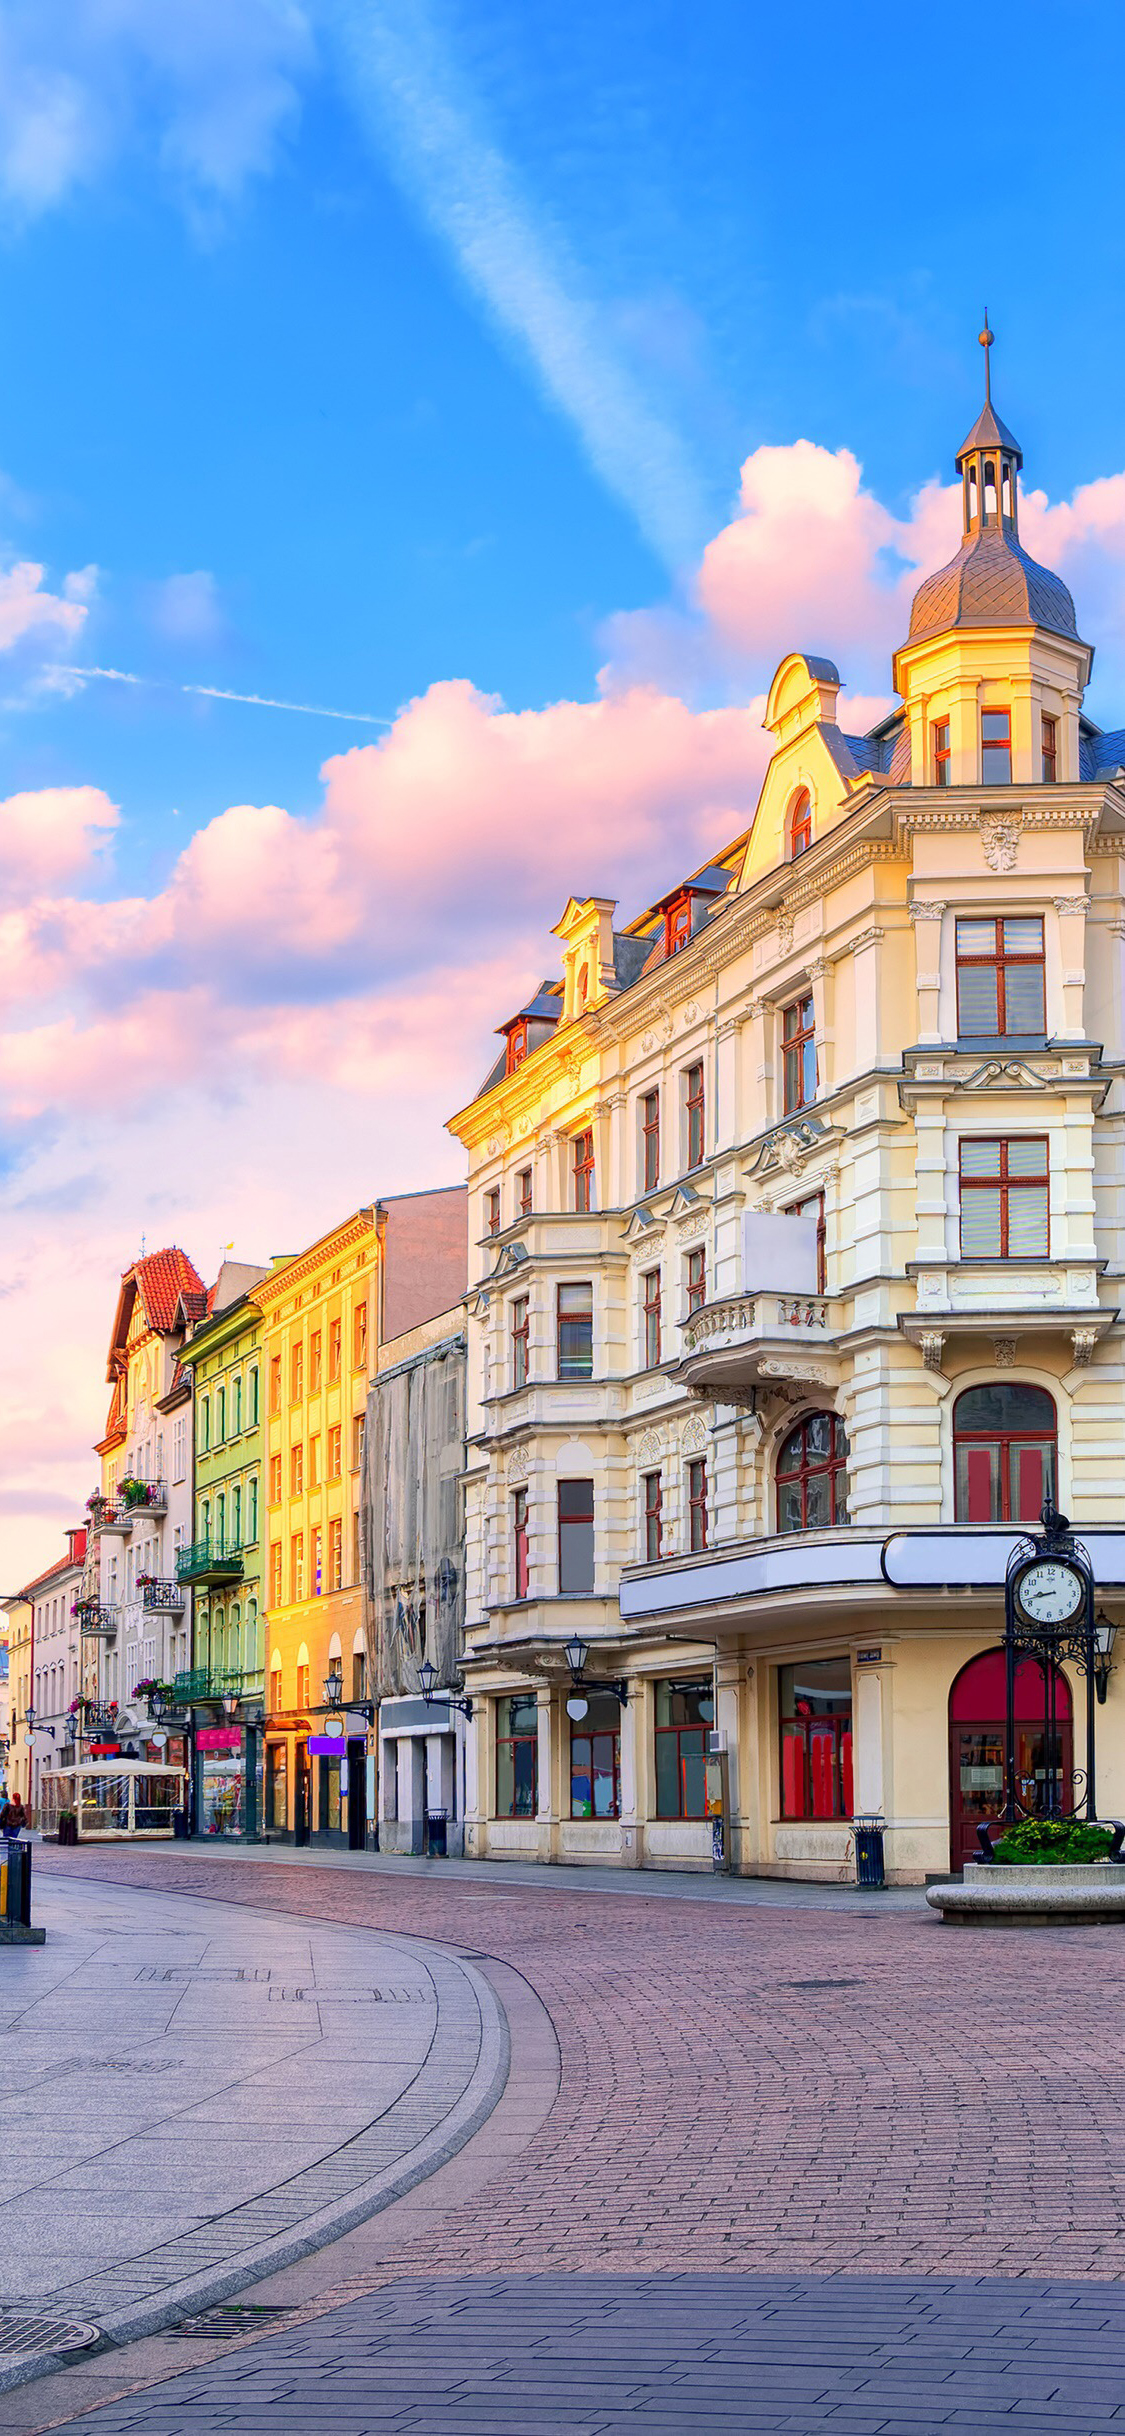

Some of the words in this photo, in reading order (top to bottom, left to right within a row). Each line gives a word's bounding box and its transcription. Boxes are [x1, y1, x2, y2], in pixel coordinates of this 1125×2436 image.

[1047, 1568, 1056, 1576] 12
[1060, 1571, 1065, 1579] 1
[1067, 1579, 1073, 1587] 2
[1071, 1590, 1077, 1598] 3
[1058, 1608, 1064, 1616] 5
